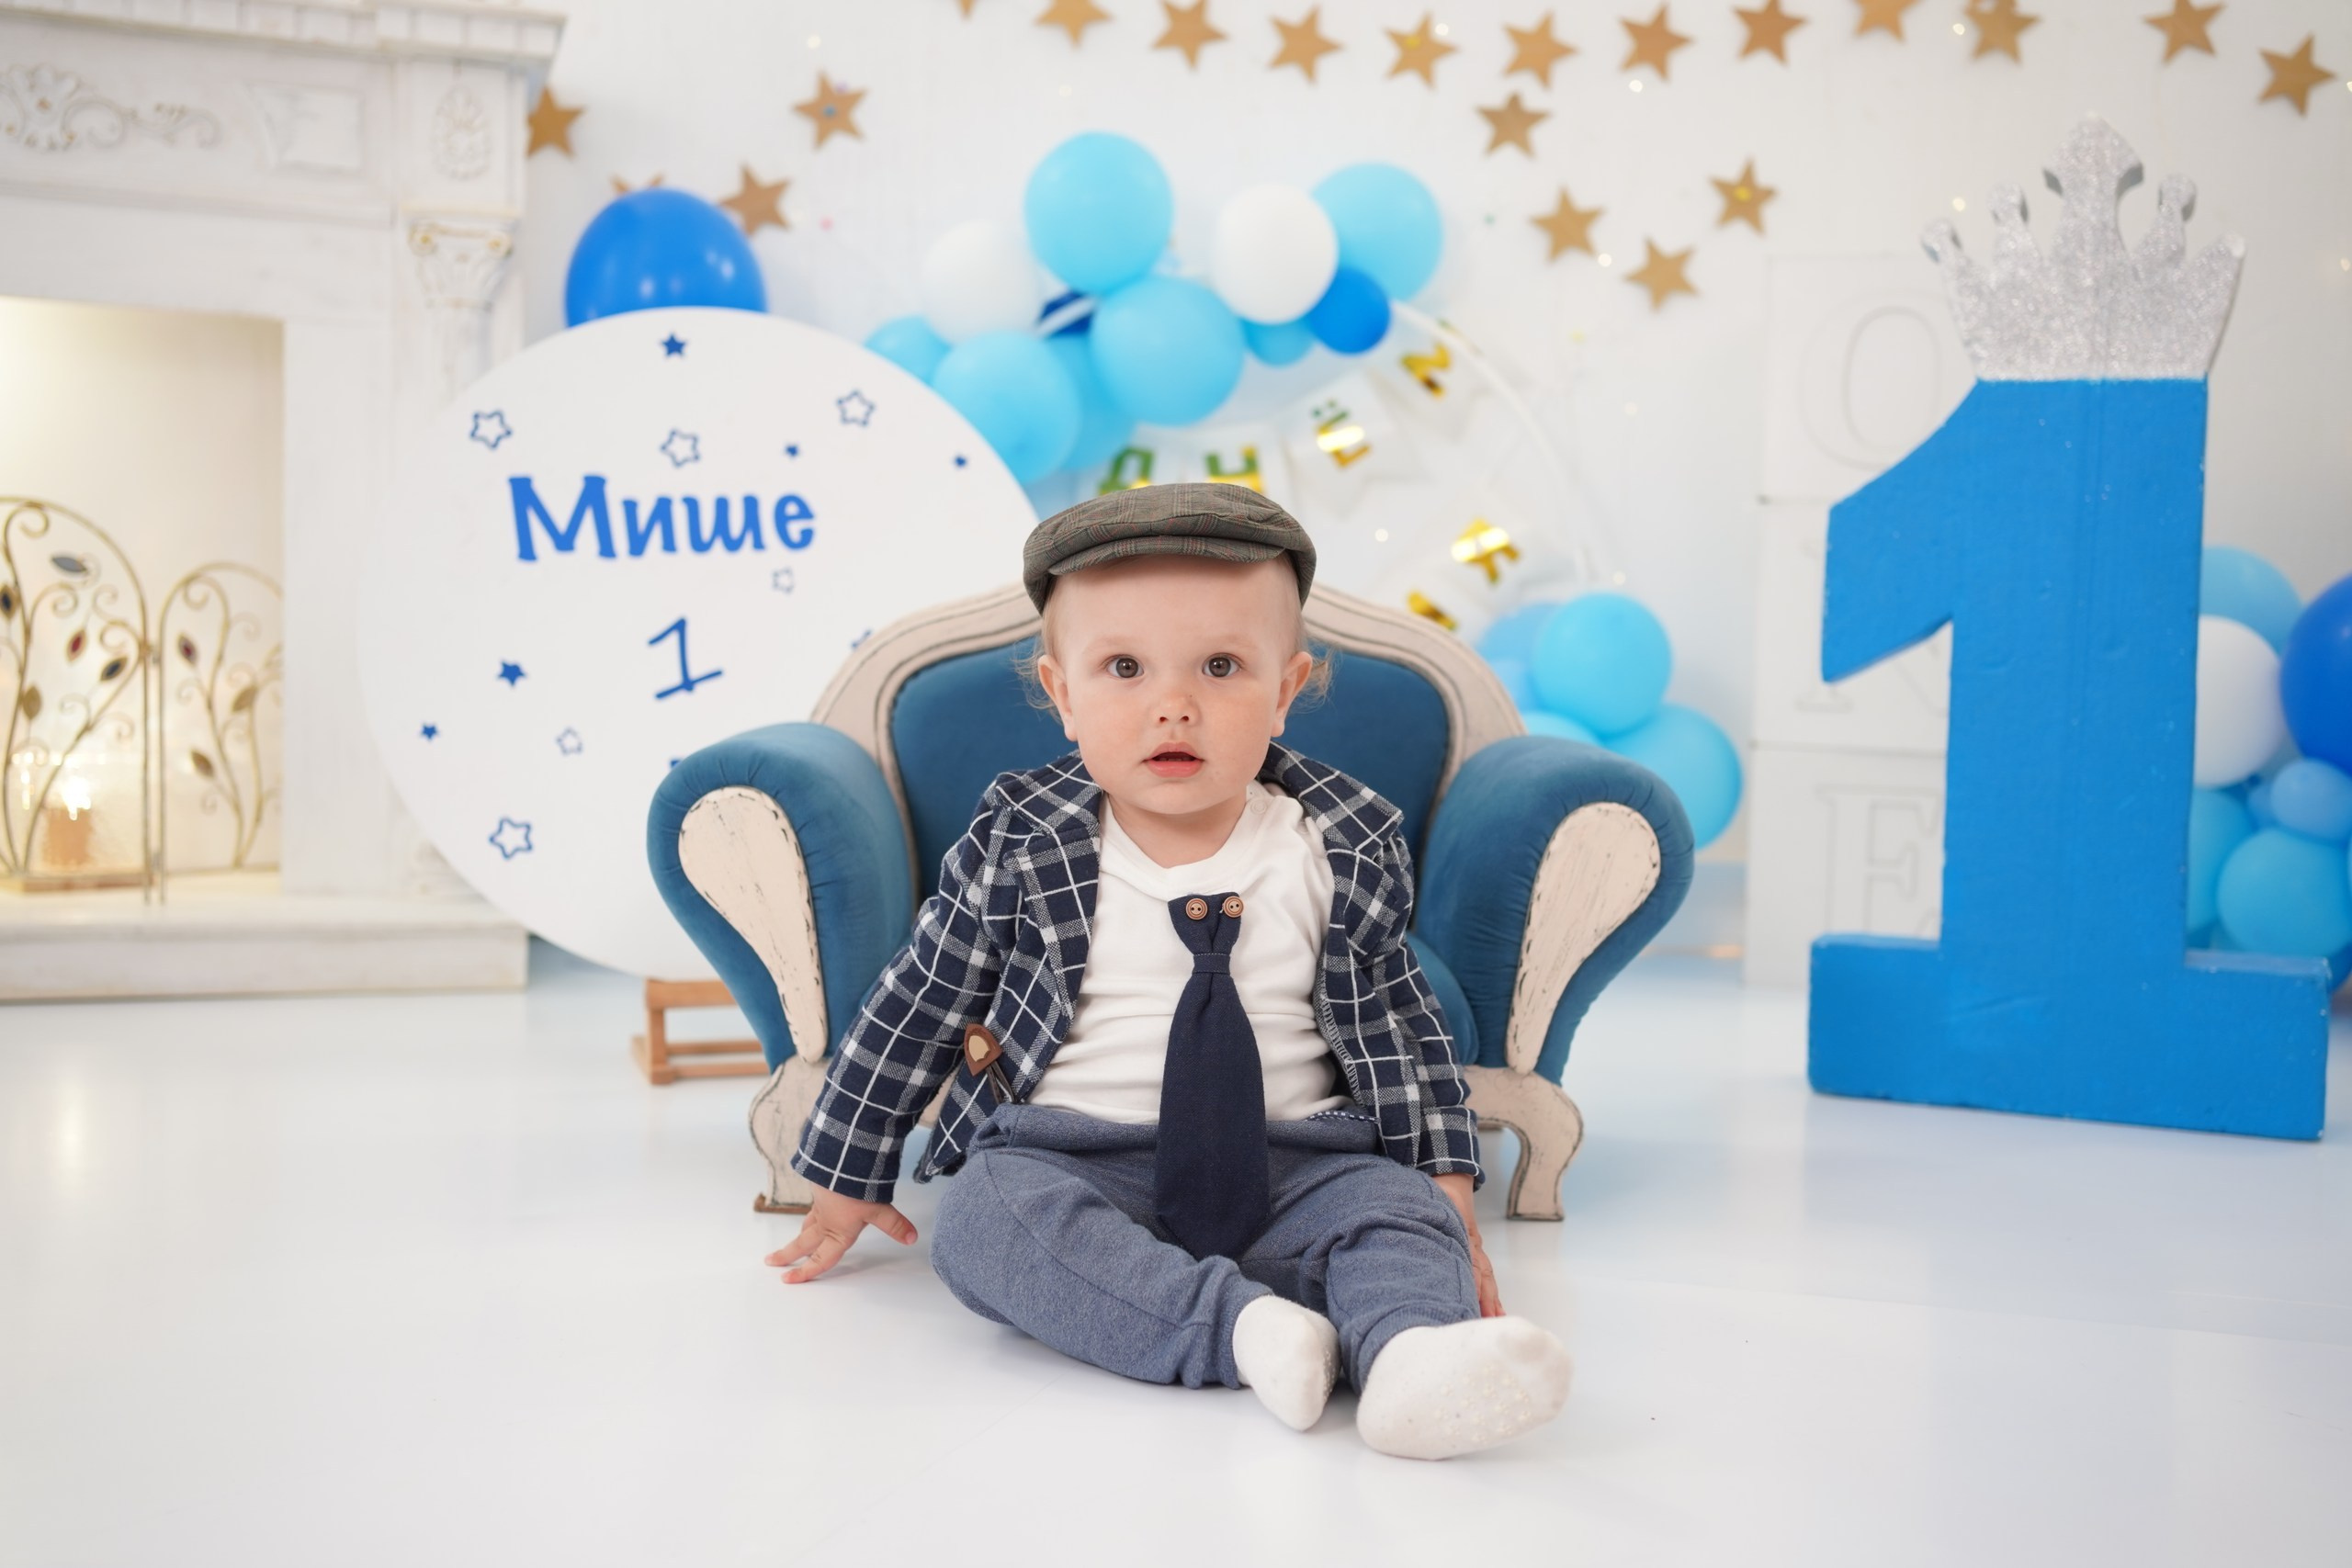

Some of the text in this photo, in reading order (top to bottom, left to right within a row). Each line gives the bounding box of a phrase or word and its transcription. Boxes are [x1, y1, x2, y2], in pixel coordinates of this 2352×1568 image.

[508, 475, 816, 563] Мише
[648, 617, 723, 701] 1
[1808, 378, 2329, 1141] 1
